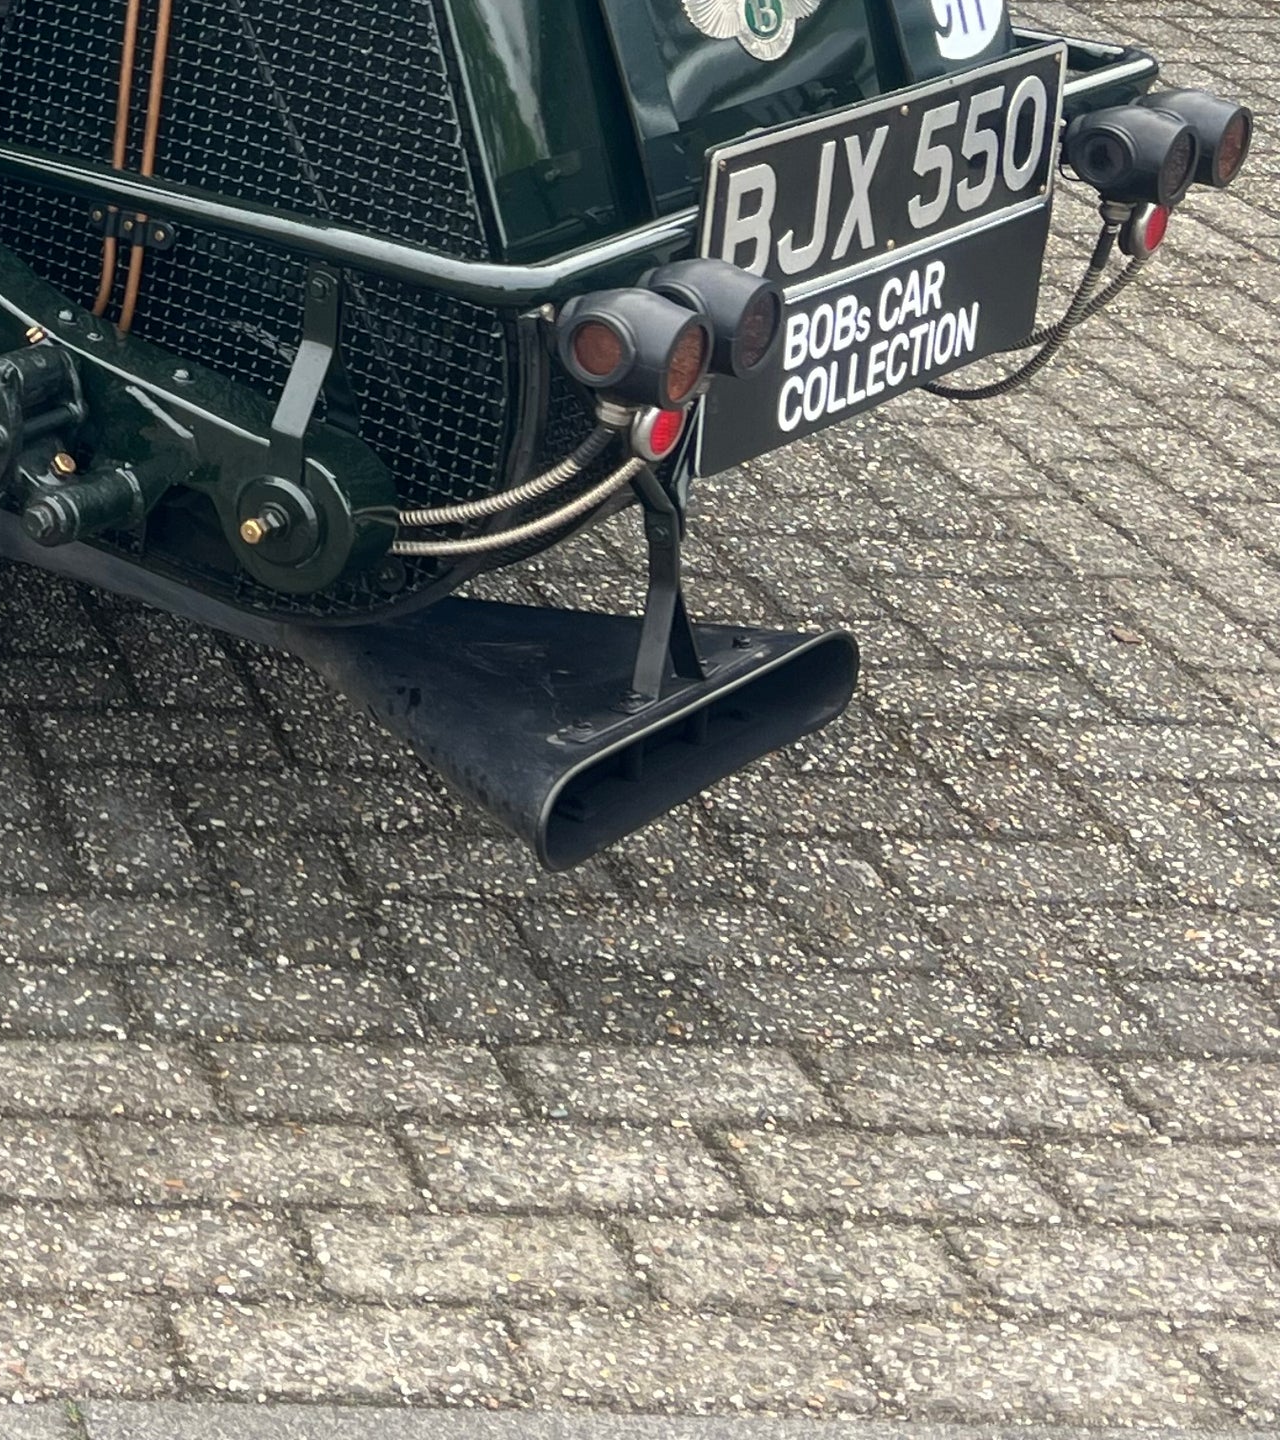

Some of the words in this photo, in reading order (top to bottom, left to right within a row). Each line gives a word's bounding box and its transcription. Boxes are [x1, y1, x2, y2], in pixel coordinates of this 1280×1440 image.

[721, 124, 889, 277] BJX
[908, 75, 1048, 229] 550
[776, 302, 980, 433] COLLECTION
[783, 302, 872, 372] BOBs
[879, 260, 946, 334] CAR
